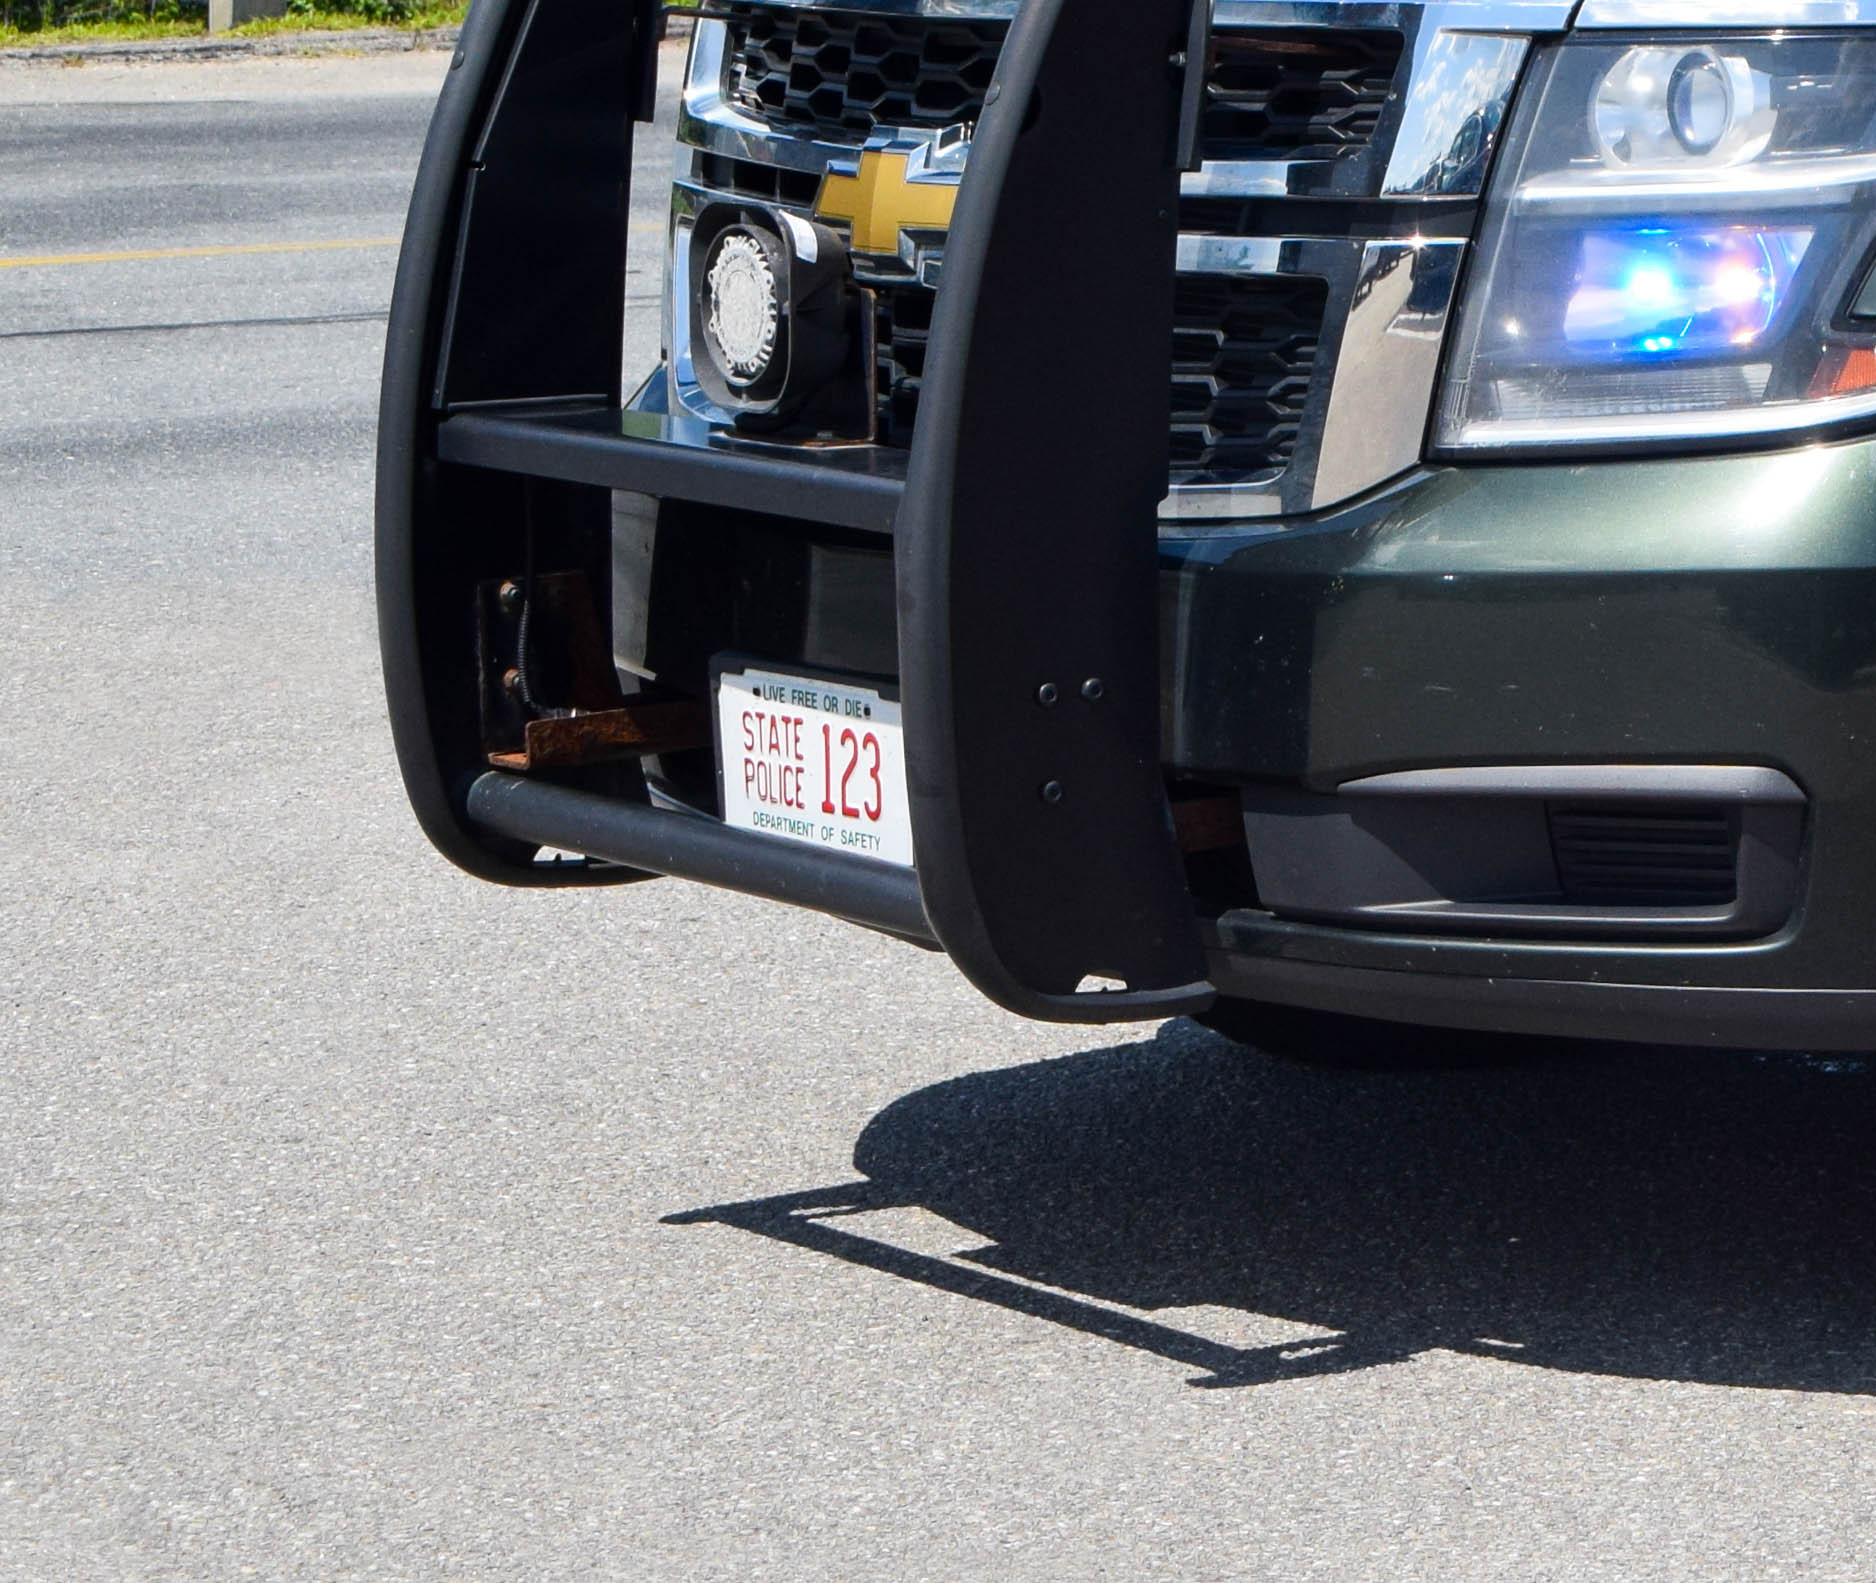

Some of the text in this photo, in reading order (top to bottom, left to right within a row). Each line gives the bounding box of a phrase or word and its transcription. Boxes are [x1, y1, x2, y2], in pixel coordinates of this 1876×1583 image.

[762, 683, 862, 717] LIVE FREE OR DIE
[742, 711, 804, 761] STATE
[743, 760, 806, 810] POLICE
[821, 723, 883, 822] 123
[753, 810, 881, 851] DEPARTMENT OF SAFETY
